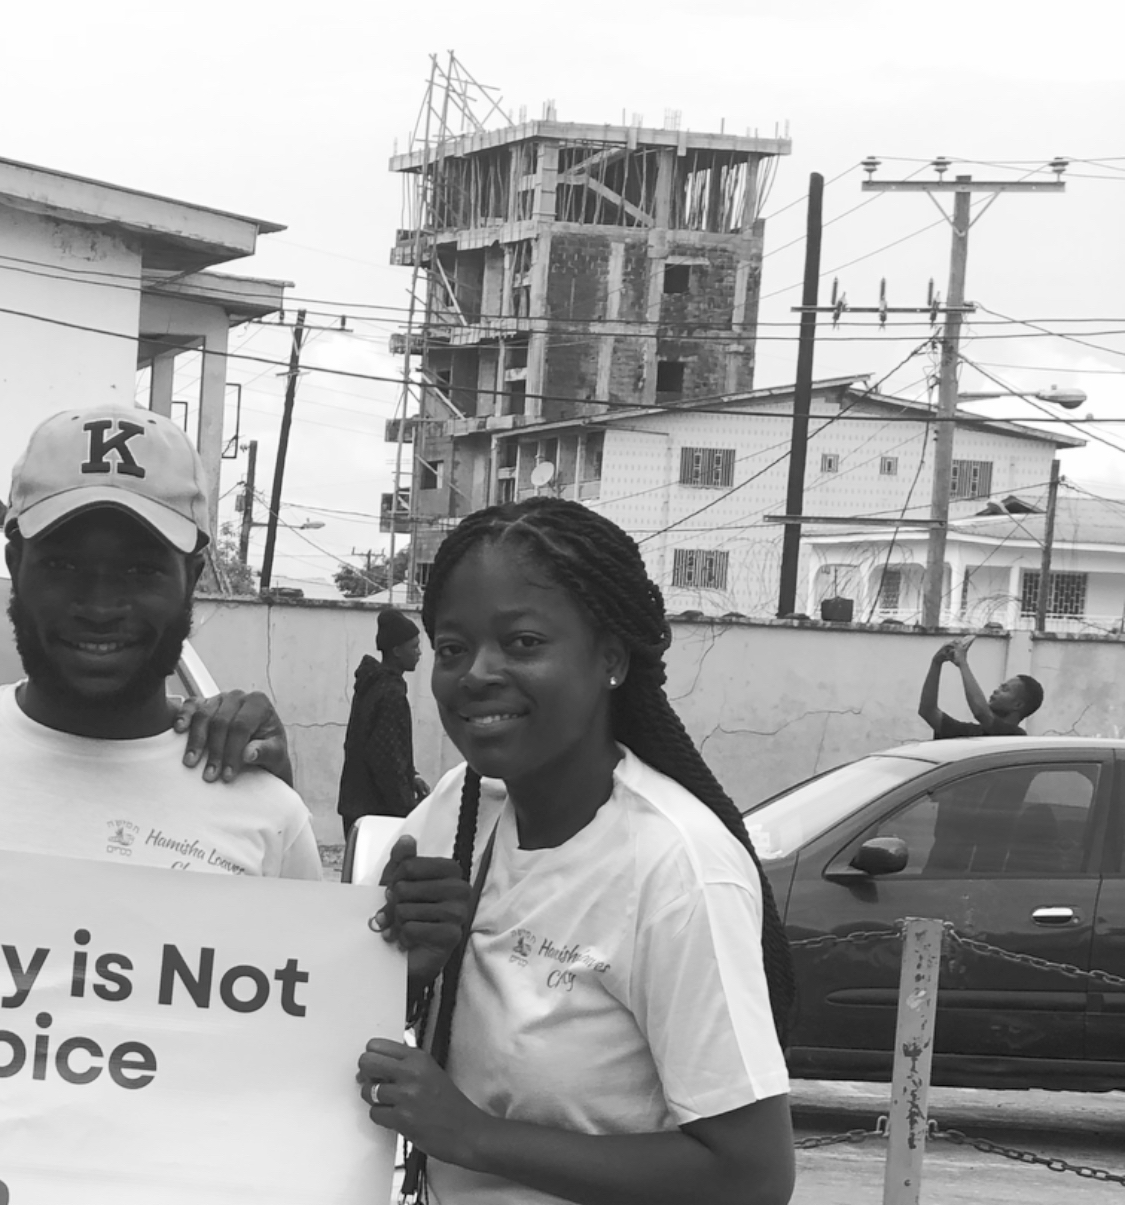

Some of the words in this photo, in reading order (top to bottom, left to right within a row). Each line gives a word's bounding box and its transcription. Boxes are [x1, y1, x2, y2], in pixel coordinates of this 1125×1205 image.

[80, 418, 145, 479] K
[145, 828, 206, 860] Hamisha
[70, 928, 134, 1002] is
[158, 943, 309, 1018] Not
